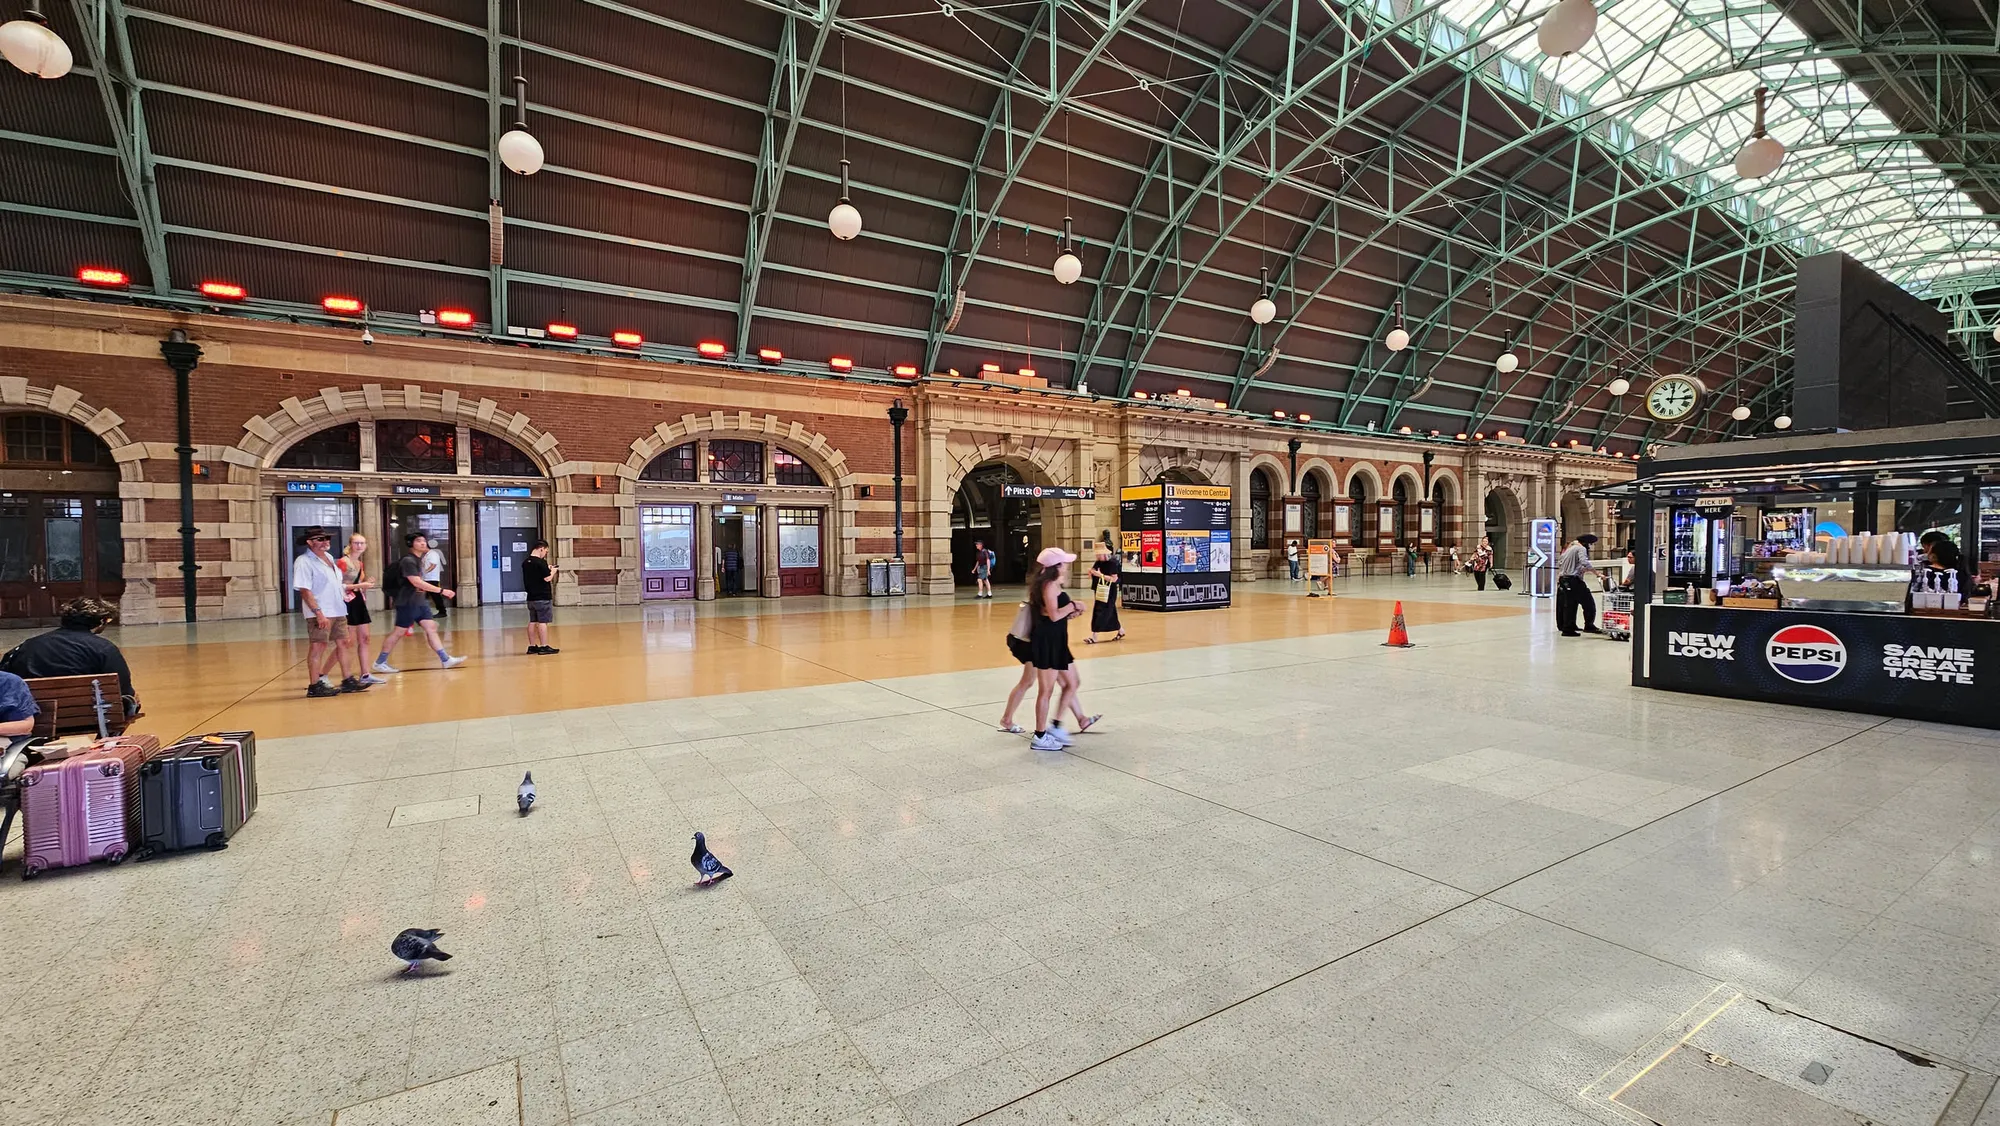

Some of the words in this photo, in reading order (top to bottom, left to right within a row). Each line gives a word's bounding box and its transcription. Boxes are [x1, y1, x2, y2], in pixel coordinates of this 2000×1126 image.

[1013, 487, 1025, 495] Pitt
[1026, 487, 1033, 495] St
[1175, 487, 1202, 496] Welcome
[1123, 538, 1141, 547] LIFT
[1669, 631, 1736, 649] NEW
[1669, 645, 1735, 661] LOOK
[1771, 646, 1841, 663] PEPSI
[1883, 643, 1974, 662] SAME
[1883, 657, 1974, 673] GREAT
[1883, 666, 1974, 685] TASTE
